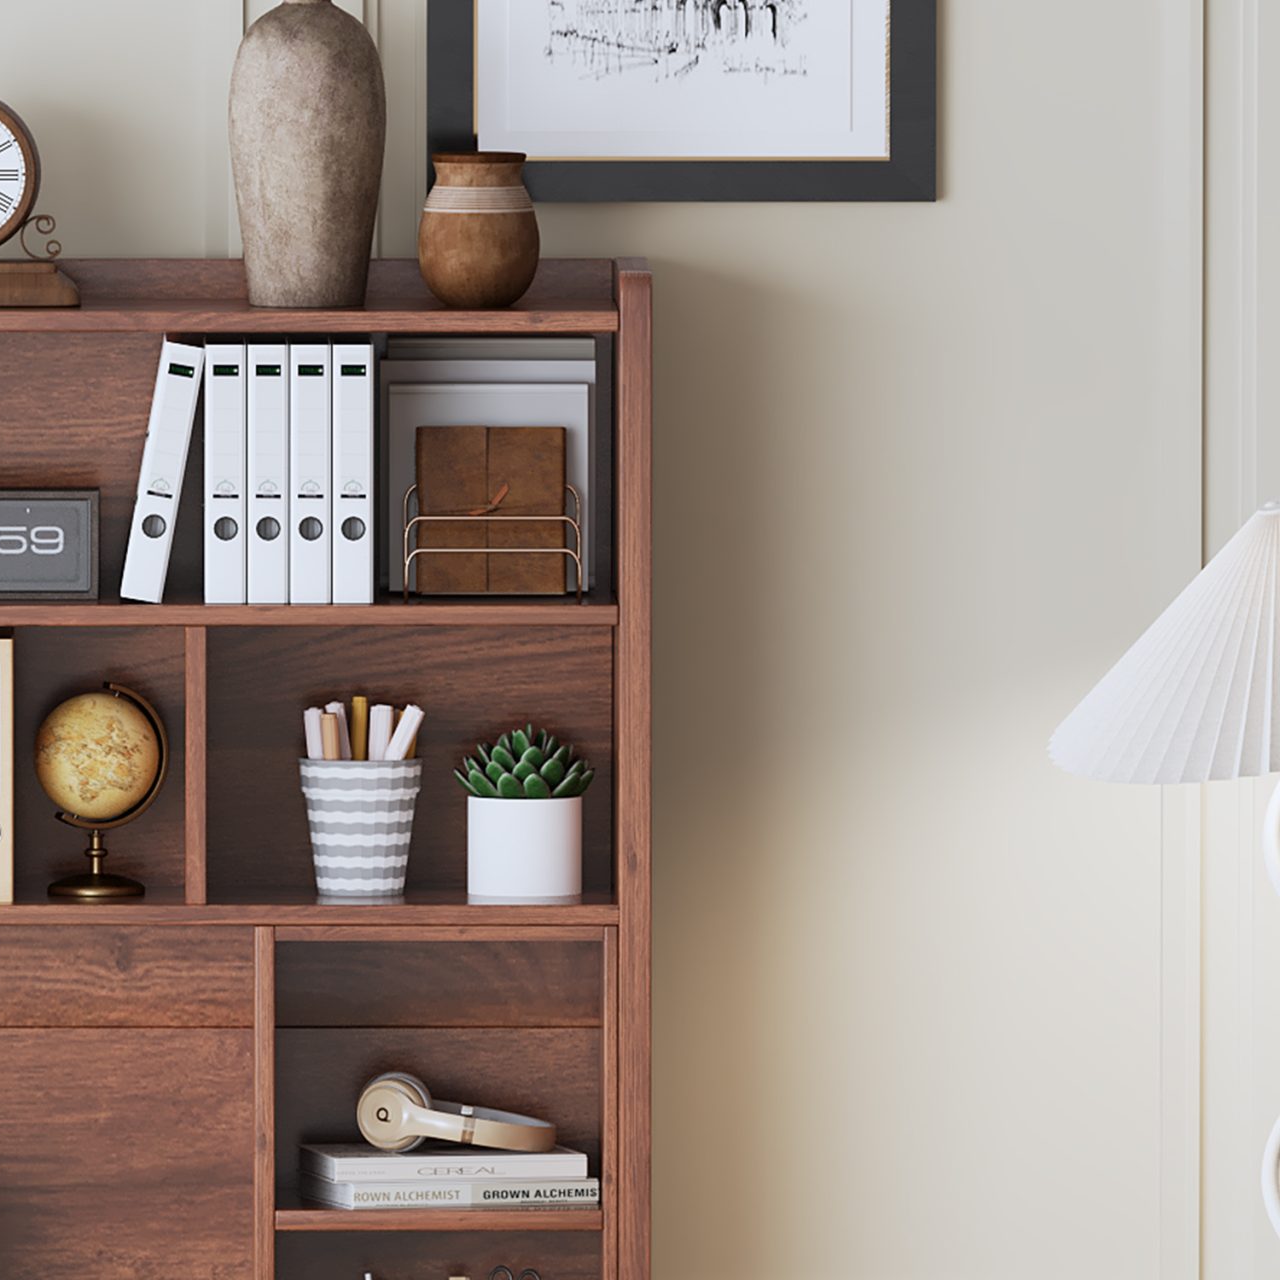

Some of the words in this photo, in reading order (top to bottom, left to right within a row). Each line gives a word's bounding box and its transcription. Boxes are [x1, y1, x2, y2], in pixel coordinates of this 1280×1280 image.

[417, 1166, 505, 1176] CEREAL
[394, 1190, 461, 1201] ALCHEMIST
[483, 1189, 530, 1200] GROWN
[534, 1188, 598, 1199] ALCHEMIS
